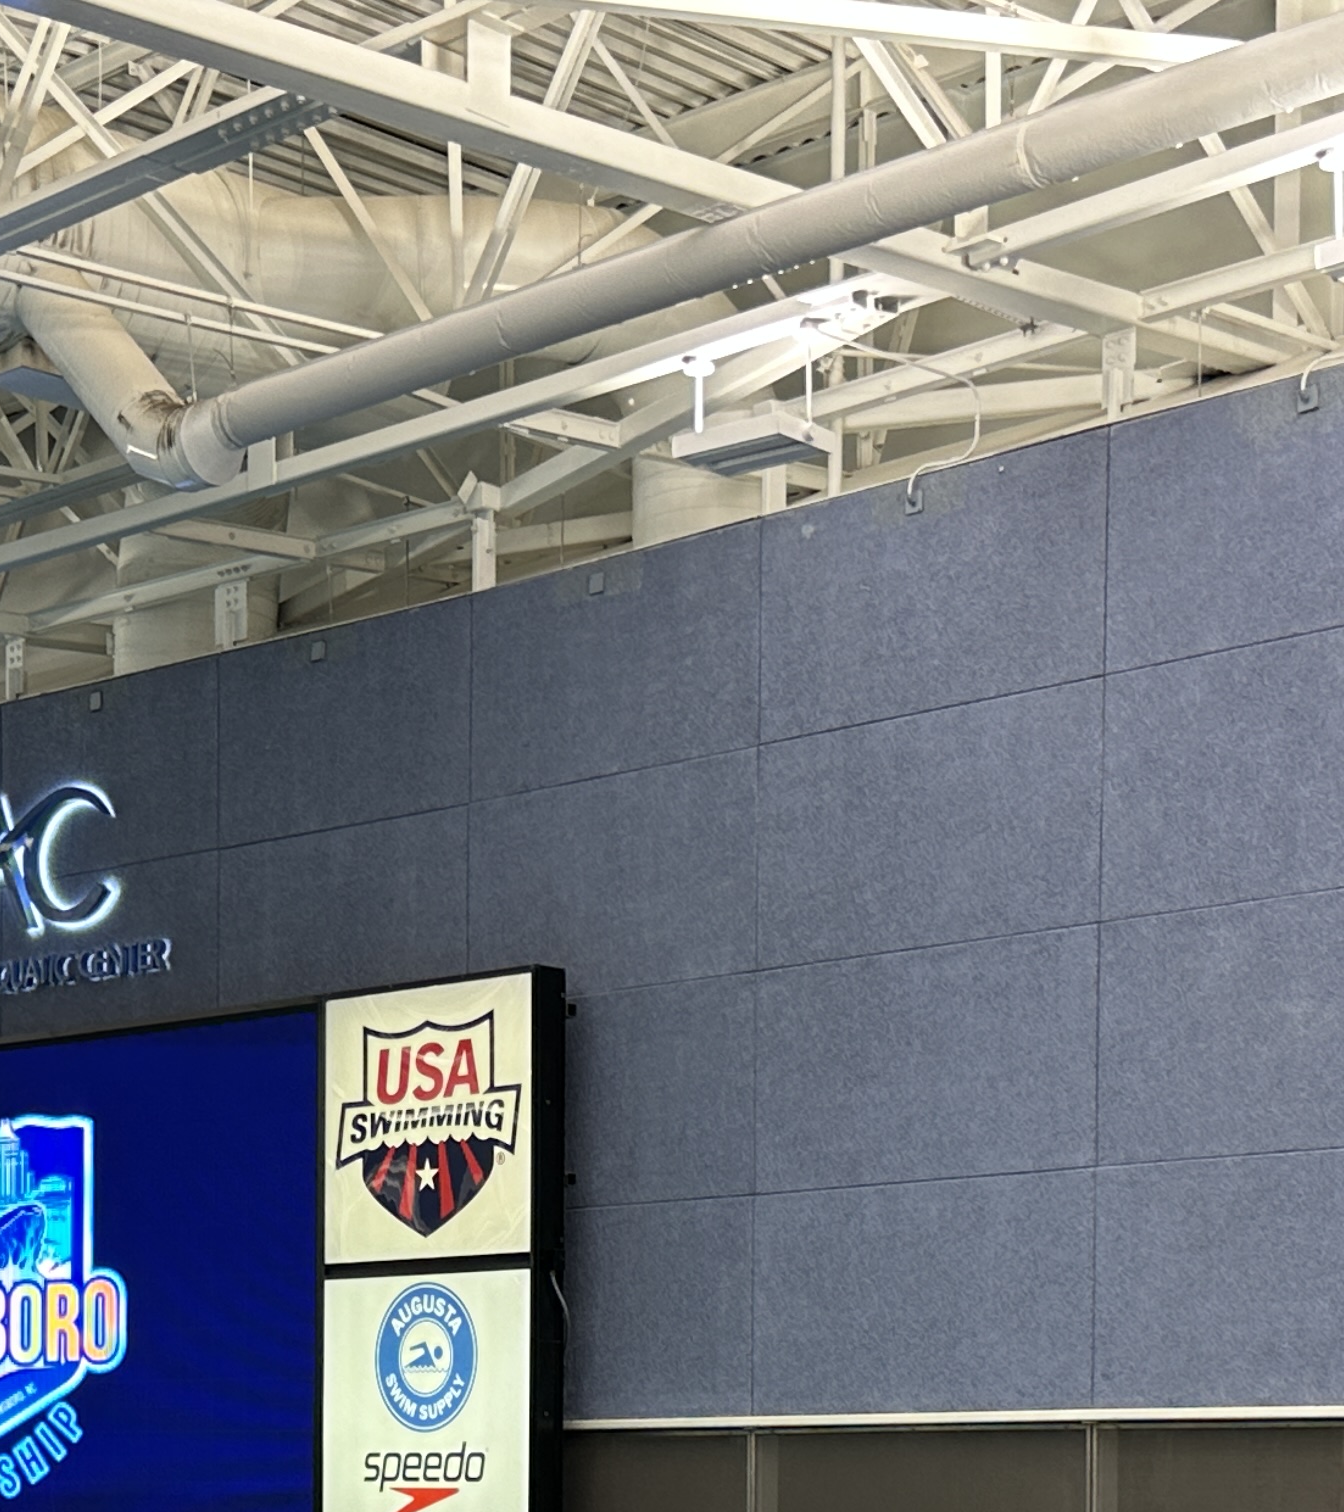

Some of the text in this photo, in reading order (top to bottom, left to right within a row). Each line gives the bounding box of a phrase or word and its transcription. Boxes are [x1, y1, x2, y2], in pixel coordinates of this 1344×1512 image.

[78, 937, 172, 982] CENTER
[376, 1038, 479, 1104] USA
[350, 1099, 505, 1144] SWIMMING
[391, 1294, 463, 1336] AUGUSTA
[385, 1373, 466, 1421] SWIM SUPPLY
[364, 1441, 485, 1492] speedo
